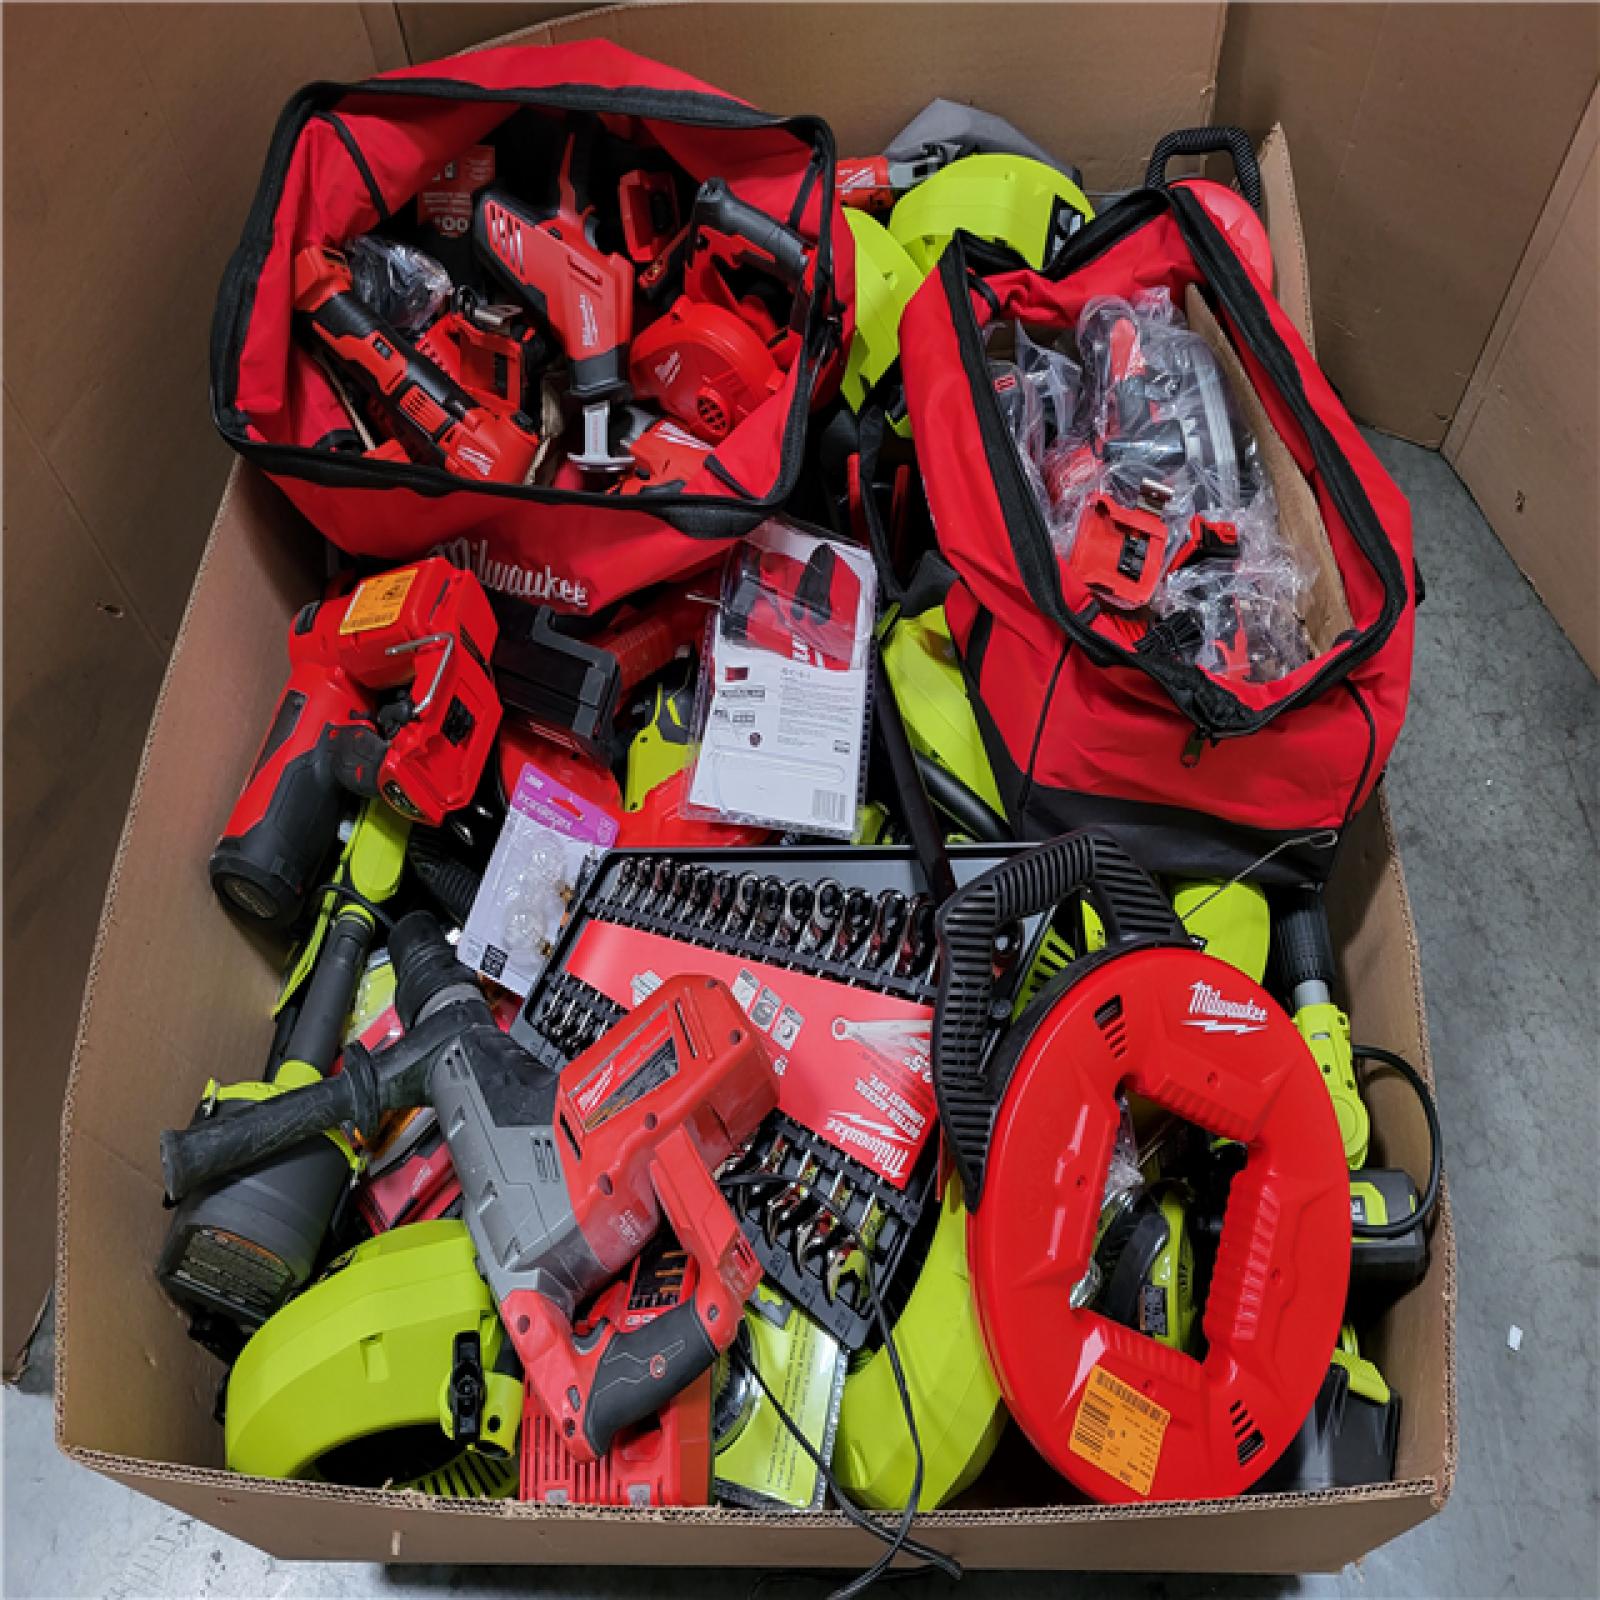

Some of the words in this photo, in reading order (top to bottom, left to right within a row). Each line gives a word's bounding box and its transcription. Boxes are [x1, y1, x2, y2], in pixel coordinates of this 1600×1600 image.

[1188, 980, 1267, 1022] Milwaukee
[887, 1107, 921, 1139] BETTER
[888, 1092, 926, 1128] LONGEST
[824, 1116, 909, 1179] Milwaukee
